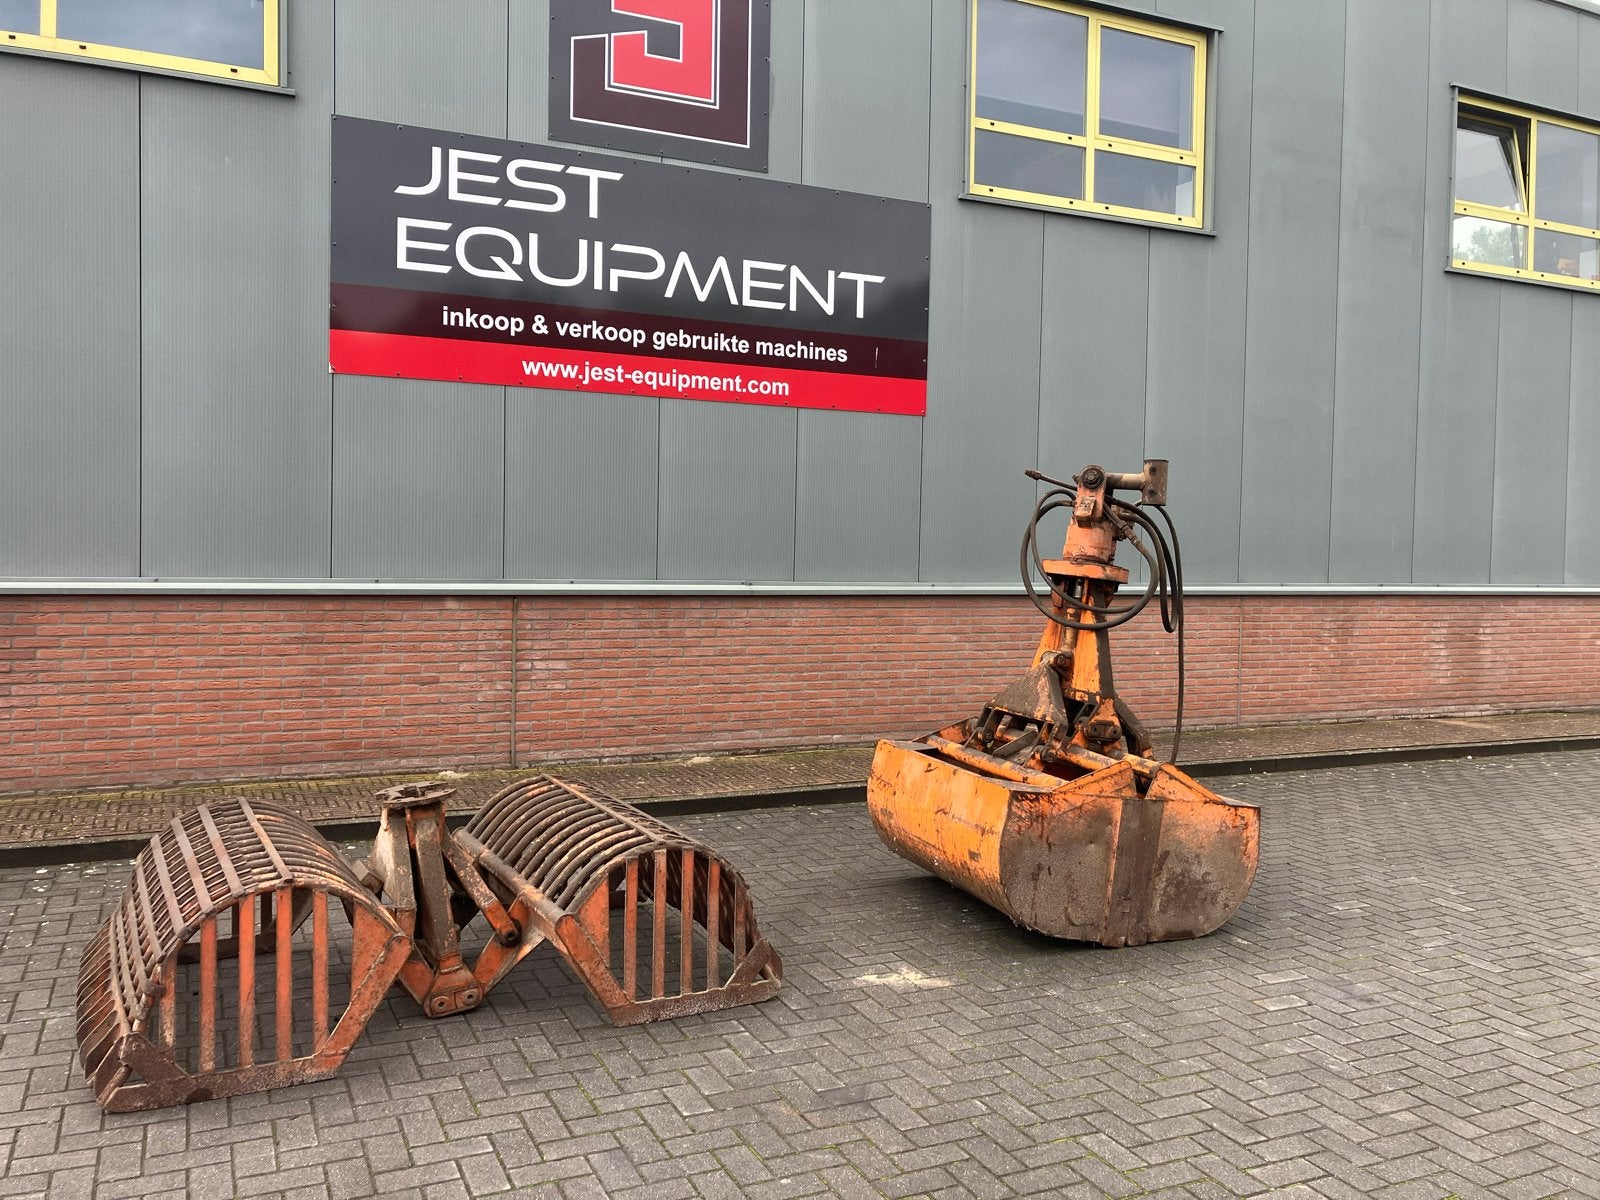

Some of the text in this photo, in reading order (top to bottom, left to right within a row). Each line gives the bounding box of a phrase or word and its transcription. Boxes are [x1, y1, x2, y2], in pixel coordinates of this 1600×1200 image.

[393, 145, 625, 220] JEST
[396, 216, 887, 320] EQUIPMENT
[442, 305, 848, 363] inkoop & verkoop gebruikte machines
[521, 360, 790, 397] www.jest-equipment.com
